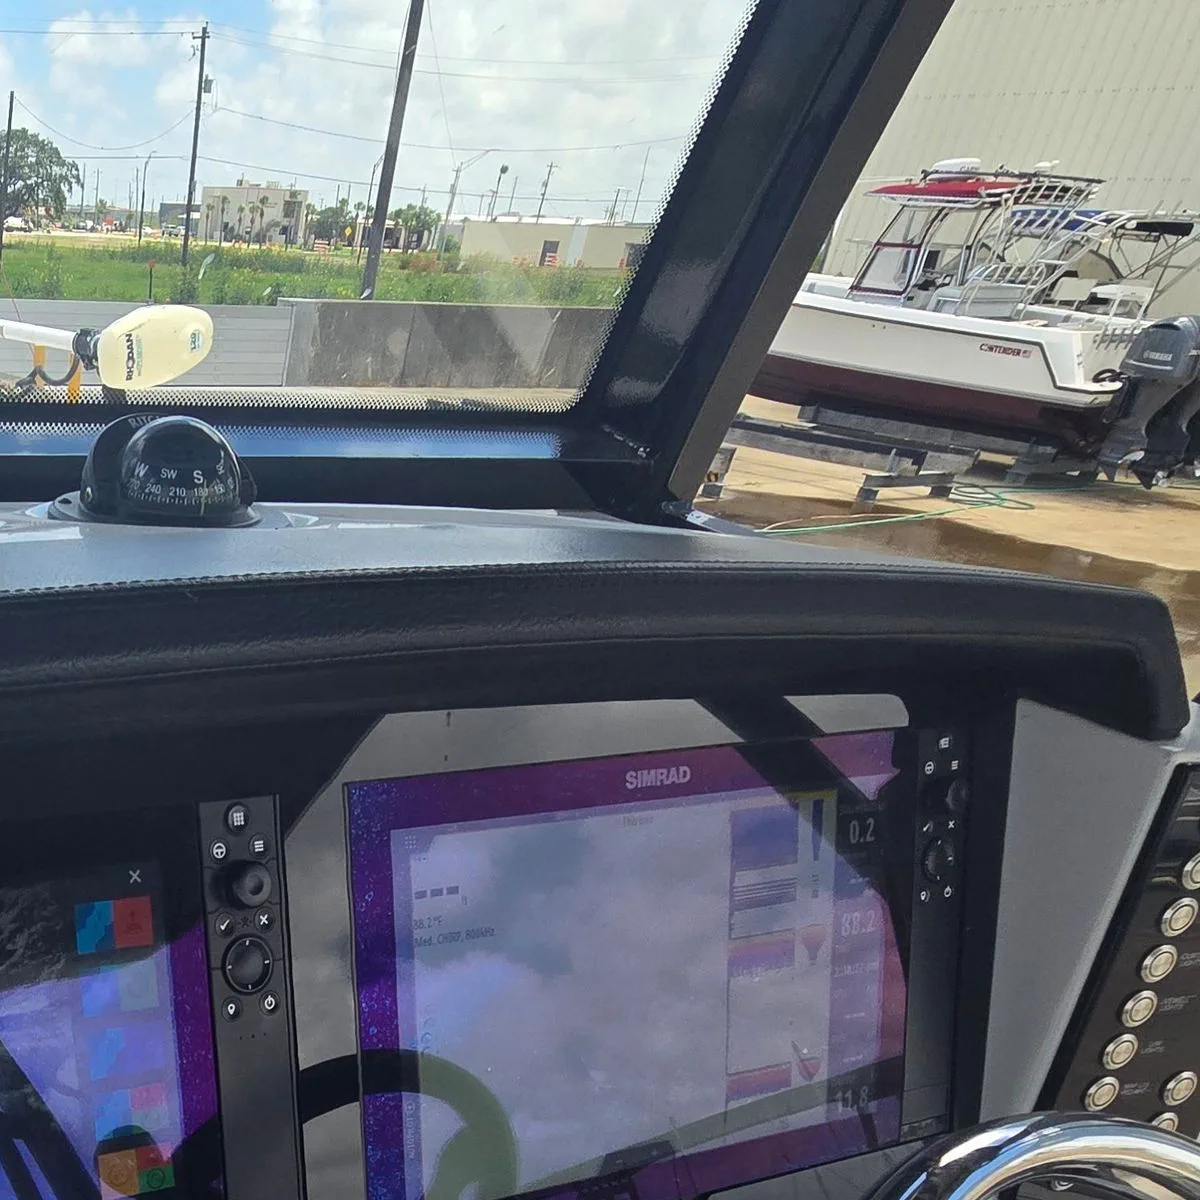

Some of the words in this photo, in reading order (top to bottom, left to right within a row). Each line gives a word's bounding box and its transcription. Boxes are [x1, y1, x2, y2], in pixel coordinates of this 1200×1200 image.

[125, 332, 136, 381] RHODAN
[134, 462, 149, 477] W
[160, 467, 178, 480] SW
[193, 470, 204, 484] S
[144, 482, 162, 495] 240
[168, 487, 187, 498] 210
[624, 765, 691, 790] SIMRAD
[849, 817, 876, 844] 0.2
